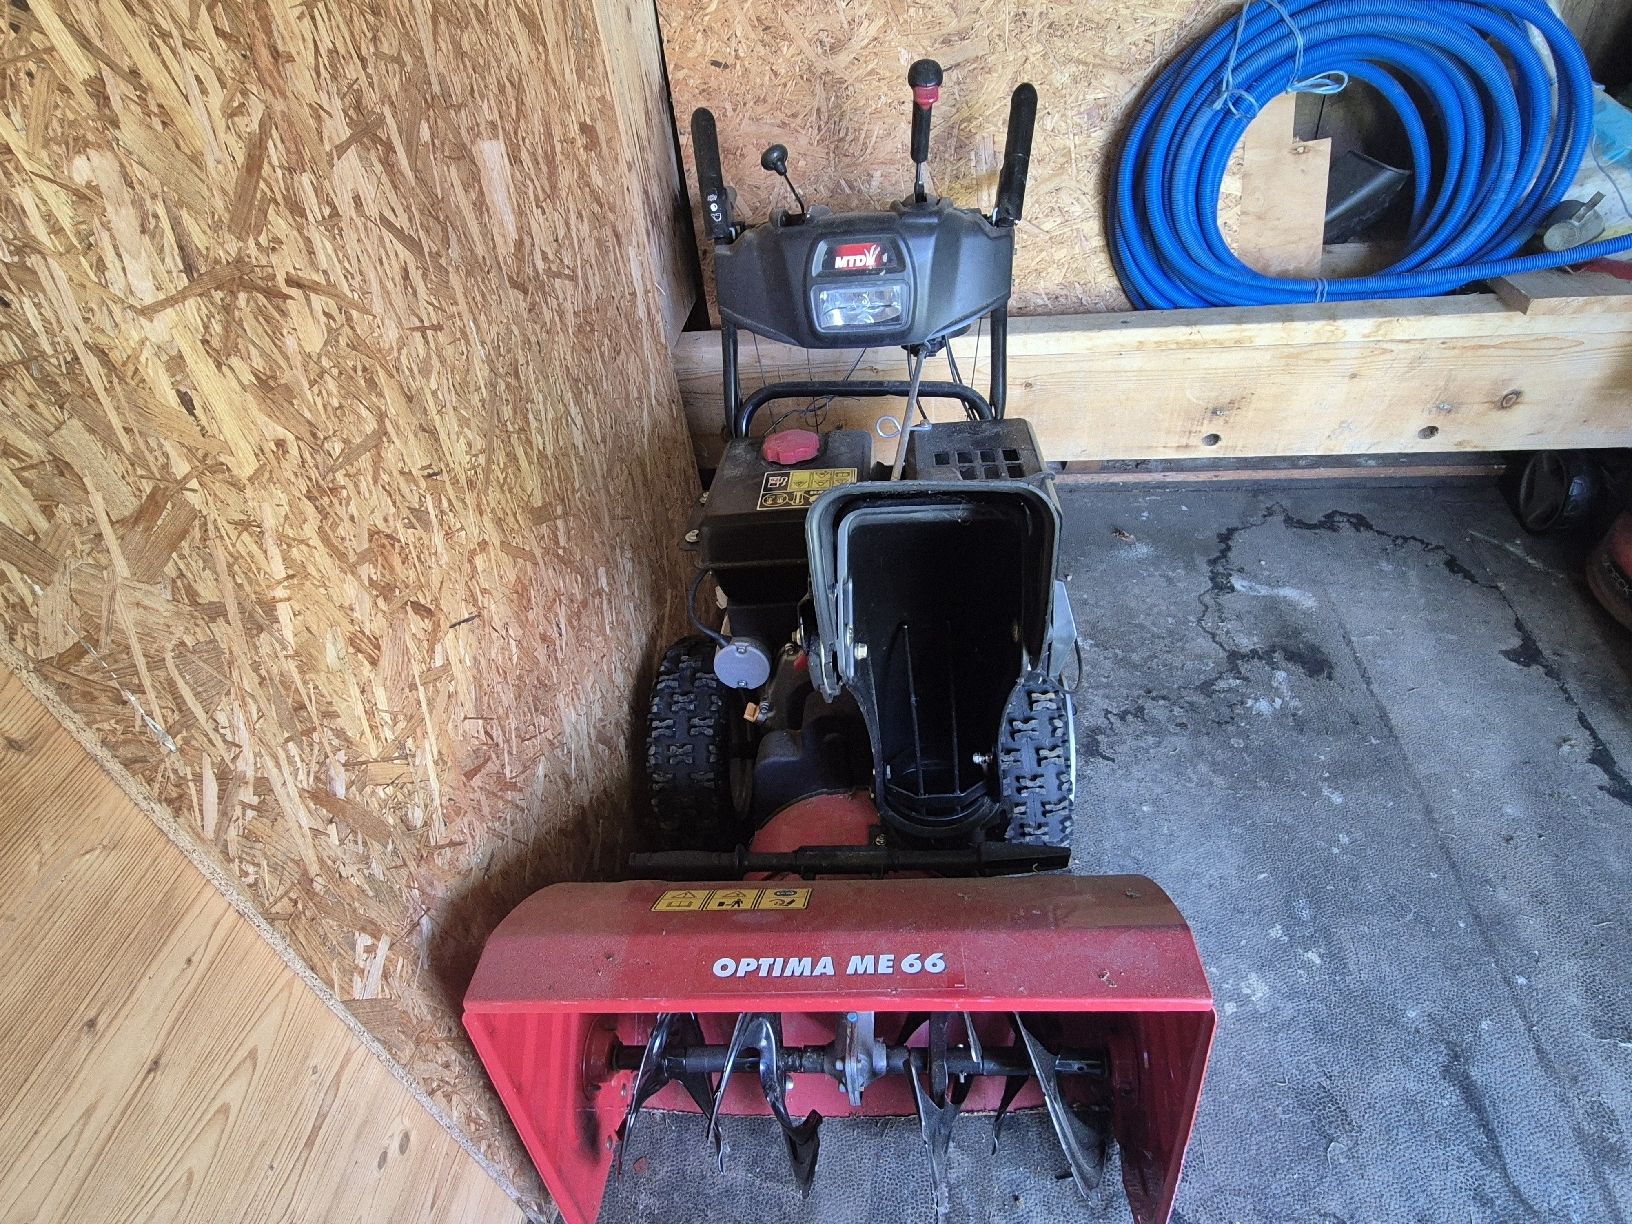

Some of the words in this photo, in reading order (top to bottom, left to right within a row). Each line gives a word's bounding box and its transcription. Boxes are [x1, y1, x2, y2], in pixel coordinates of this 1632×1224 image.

[835, 254, 867, 269] MTD
[712, 956, 835, 977] OPTIMA
[846, 954, 895, 975] ME
[900, 953, 946, 974] 66
